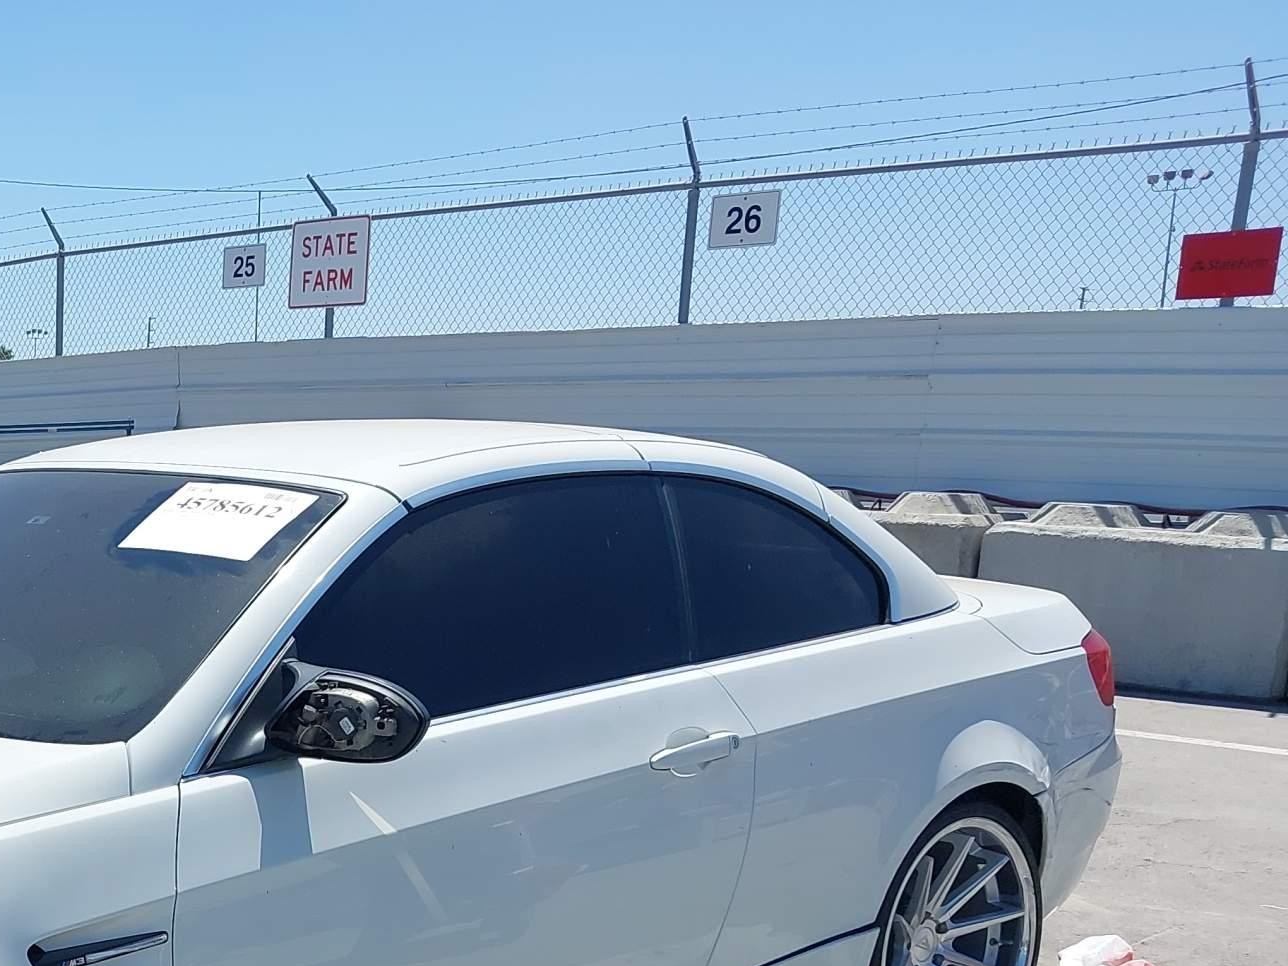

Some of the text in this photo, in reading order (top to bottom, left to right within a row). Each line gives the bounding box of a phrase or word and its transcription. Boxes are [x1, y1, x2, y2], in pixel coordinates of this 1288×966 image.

[725, 204, 762, 235] 26
[301, 232, 358, 258] STATE
[233, 255, 256, 278] 25
[302, 267, 353, 293] FARM
[176, 497, 283, 518] 45785612
